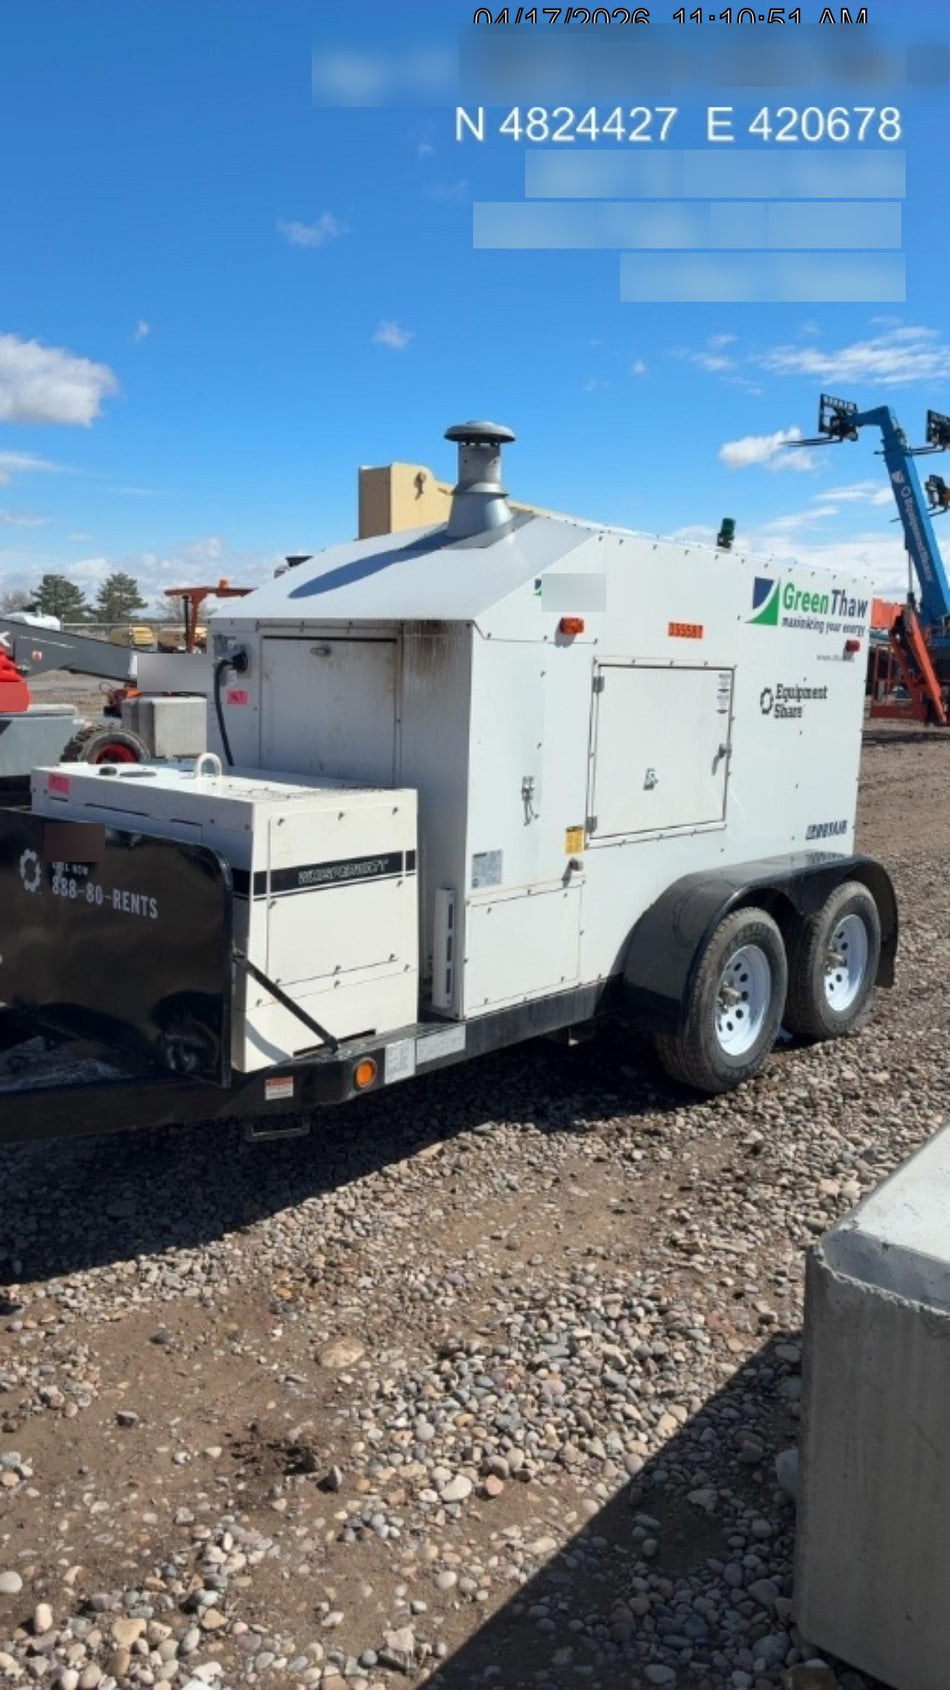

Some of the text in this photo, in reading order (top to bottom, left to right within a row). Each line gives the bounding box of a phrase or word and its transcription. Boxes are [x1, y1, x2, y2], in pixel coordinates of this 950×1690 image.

[775, 682, 828, 702] Equipment
[774, 704, 802, 719] Share
[51, 876, 159, 919] 888-80-RENTS
